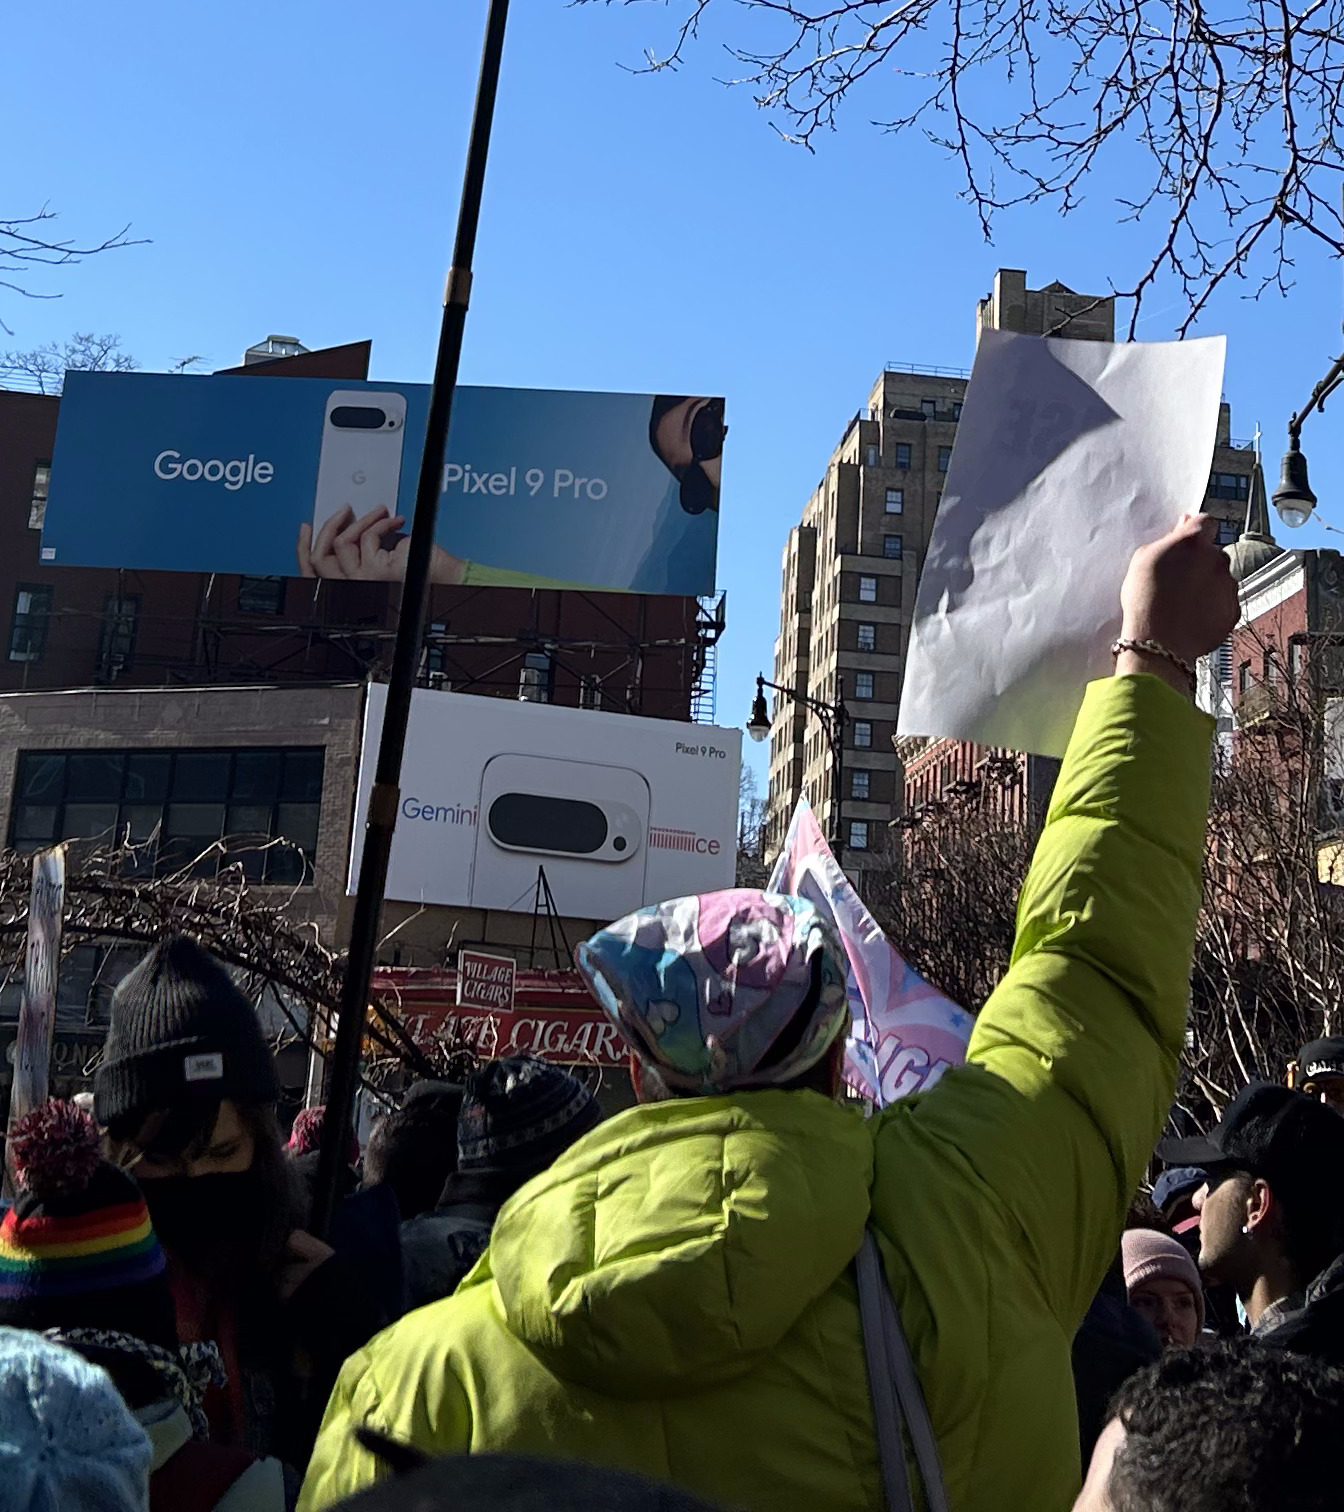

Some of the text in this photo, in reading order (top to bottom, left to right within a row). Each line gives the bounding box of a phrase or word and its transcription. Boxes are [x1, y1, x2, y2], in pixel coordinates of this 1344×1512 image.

[154, 449, 274, 490] Google
[441, 463, 608, 500] Pixel 9 Pro
[676, 742, 726, 759] Pixel 9 Pro
[402, 797, 478, 826] Gemini
[465, 961, 513, 985] VILLAGE
[464, 980, 511, 1008] CIGARS
[512, 1018, 632, 1061] CIGAR
